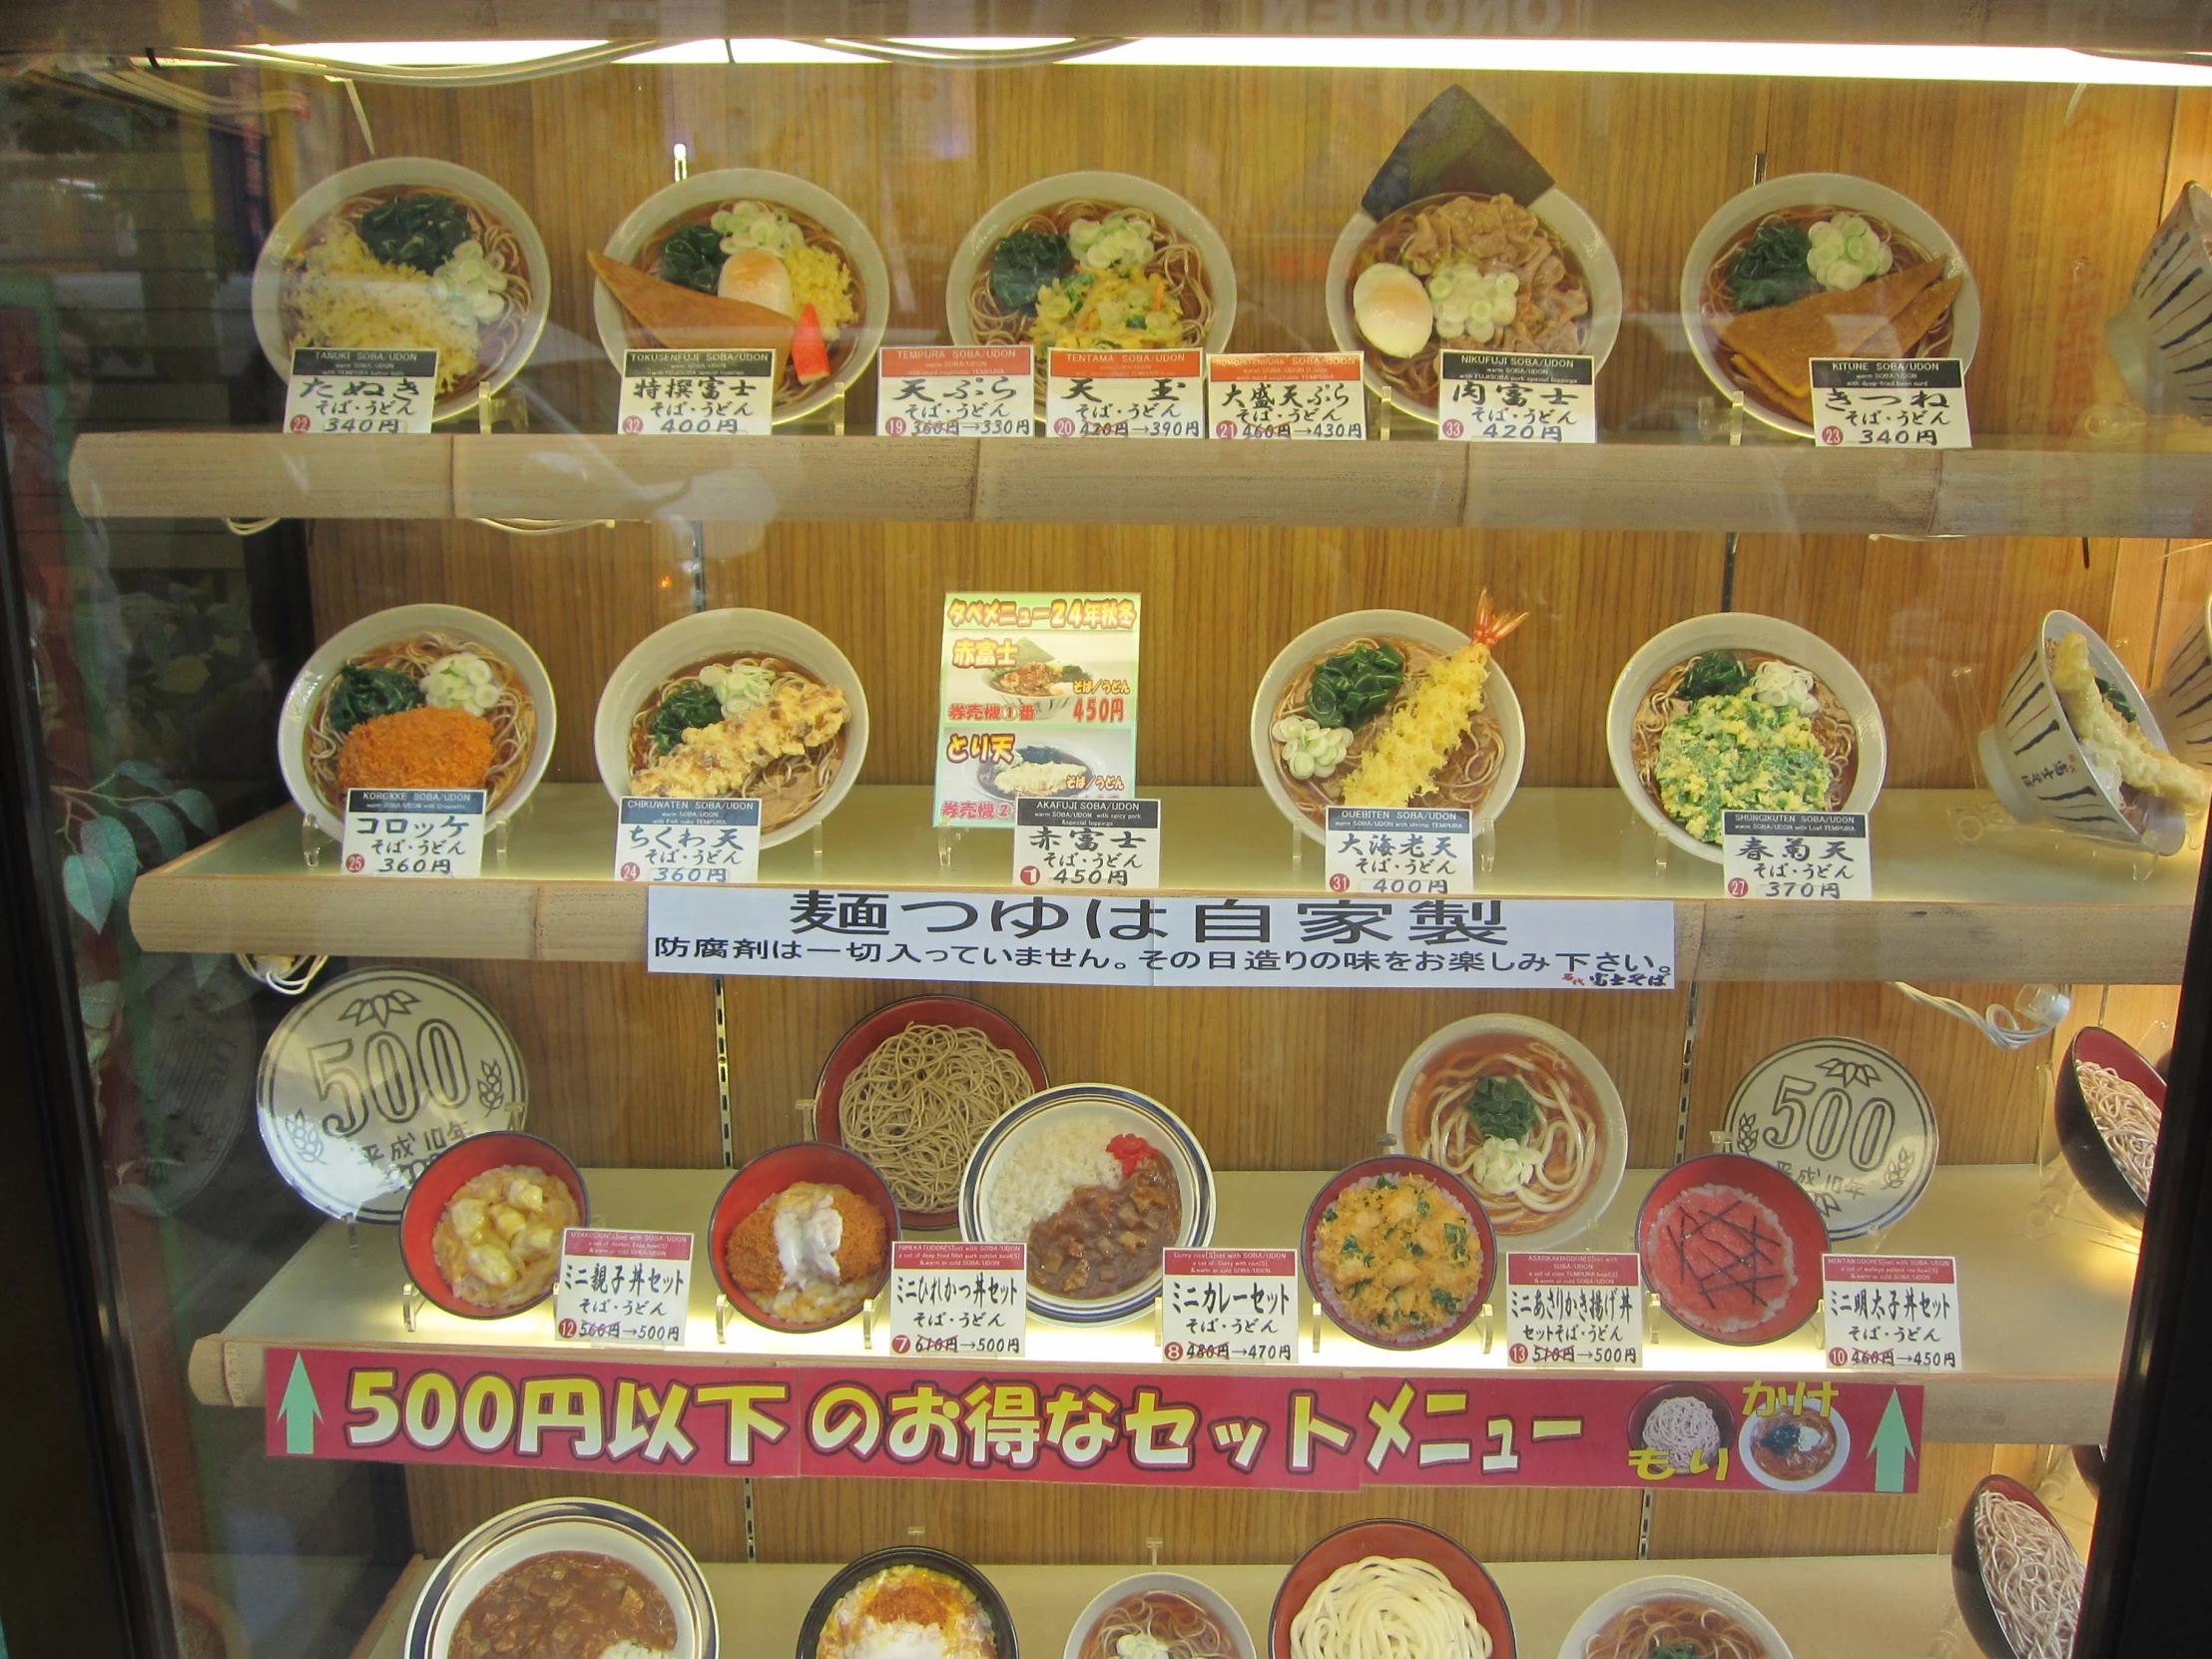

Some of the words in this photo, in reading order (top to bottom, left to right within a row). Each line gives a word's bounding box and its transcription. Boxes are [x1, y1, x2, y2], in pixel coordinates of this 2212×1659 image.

[315, 351, 350, 360] TANUKI
[357, 351, 417, 361] SOBA/UDON
[631, 353, 700, 362] TOKUSENFUJI
[706, 353, 769, 362] SOBA/UDON
[896, 349, 945, 359] TEMPURA
[952, 349, 1016, 358] SOBA/UDON
[1066, 353, 1115, 362] TENTAMA
[1122, 353, 1186, 362] SOBA/UDON
[1460, 354, 1508, 365] NIKUFUJI
[1510, 357, 1574, 368] SOBA/UDON
[1832, 361, 1869, 371] KITUNE
[1877, 361, 1939, 371] SOBA/UDON
[298, 376, 420, 405] たぬき
[892, 376, 1016, 403] 天ぷら
[1061, 376, 1187, 403] 天玉
[1222, 382, 1351, 409] 大盛天ぷら
[1452, 381, 1580, 407] 肉富士
[1825, 385, 1950, 412] きつね
[315, 400, 416, 418] そば・うどん
[650, 401, 755, 418] そば・うどん
[904, 401, 1011, 420] そば・うどん
[1075, 402, 1183, 421] そば・うどん
[1236, 407, 1343, 425] そば・うどん
[1471, 405, 1580, 426] そば・うどん
[1845, 409, 1951, 427] そば・うどん
[292, 419, 309, 431] 22
[324, 418, 399, 434] 340円
[625, 419, 642, 431] 32
[661, 418, 738, 434] 400円
[888, 420, 904, 433] 19
[981, 419, 1030, 436] 330円
[1057, 421, 1073, 433] 20
[1150, 420, 1200, 437] 390円
[1219, 425, 1236, 437] 21
[1314, 423, 1363, 439] 430円
[1445, 421, 1461, 435] 33
[1483, 423, 1563, 442] 420円
[1826, 429, 1842, 442] 23
[1859, 429, 1938, 446] 340円
[952, 638, 1019, 668] 赤富士
[1072, 697, 1124, 722] 450円
[946, 733, 1015, 764] とり天
[363, 792, 407, 801] KOROKKE
[414, 792, 471, 802] SOBA/UDON
[627, 801, 689, 810] CHIKUWATEN
[695, 801, 754, 811] SOBA/UDON
[1036, 801, 1078, 811] AKAFUJI
[1079, 802, 1140, 812] SOBA/UDON
[1341, 810, 1390, 819] OUEBITEN
[1396, 811, 1457, 821] SOBA/UDON
[1735, 814, 1796, 824] SHUNGIKUTEN
[1801, 816, 1856, 825] SOBA/UDON
[356, 815, 470, 841] コロッケ
[370, 837, 466, 857] そば・うどん
[629, 825, 745, 854] ちくわ天
[1028, 826, 1147, 852] 赤富士
[1337, 832, 1458, 859] 大海老天
[645, 849, 743, 867] そば・うどん
[1735, 836, 1855, 862] 春菊天
[347, 857, 363, 869] 25
[382, 858, 452, 875] 360円
[1043, 850, 1144, 871] そば・うどん
[1356, 858, 1457, 877] そば・うどん
[623, 866, 639, 879] 24
[653, 866, 729, 885] 360円
[1024, 869, 1037, 882] 1
[1053, 868, 1129, 886] 450円
[1753, 862, 1855, 882] そば・うどん
[1333, 877, 1349, 890] 31
[1373, 878, 1448, 896] 400円
[1731, 882, 1747, 896] 27
[1764, 881, 1841, 899] 370円
[789, 889, 1509, 945] 麺つゆは自家製
[307, 1018, 470, 1138] 500
[1762, 1074, 1896, 1172] 500
[564, 1262, 685, 1298] ミニ親子丼セット
[897, 1271, 1018, 1310] ミニひれかつ丼セット
[1172, 1282, 1290, 1316] ミニカレーセット
[579, 1298, 668, 1317] そば・うどん
[1511, 1287, 1633, 1325] ミニあさりかき揚げ丼
[1831, 1286, 1950, 1323] ミニ明太子丼セット
[913, 1311, 1006, 1329] そば・うどん
[1186, 1318, 1280, 1336] そば・うどん
[561, 1321, 576, 1337] 12
[639, 1326, 680, 1343] 500円
[1523, 1324, 1624, 1343] セットそば・うどん
[1848, 1326, 1941, 1344] そば・うどん
[896, 1338, 907, 1353] 7
[976, 1337, 1020, 1354] 500円
[1169, 1345, 1179, 1359] 8
[1248, 1345, 1292, 1362] 470円
[1513, 1347, 1527, 1362] 13
[1594, 1346, 1637, 1364] 500円
[1833, 1350, 1847, 1366] 10
[1914, 1351, 1956, 1369] 450円
[1744, 1381, 1839, 1418] かけ
[343, 1368, 1585, 1479] 500円以下のお得なセットメニュー
[1628, 1447, 1729, 1481] もり
